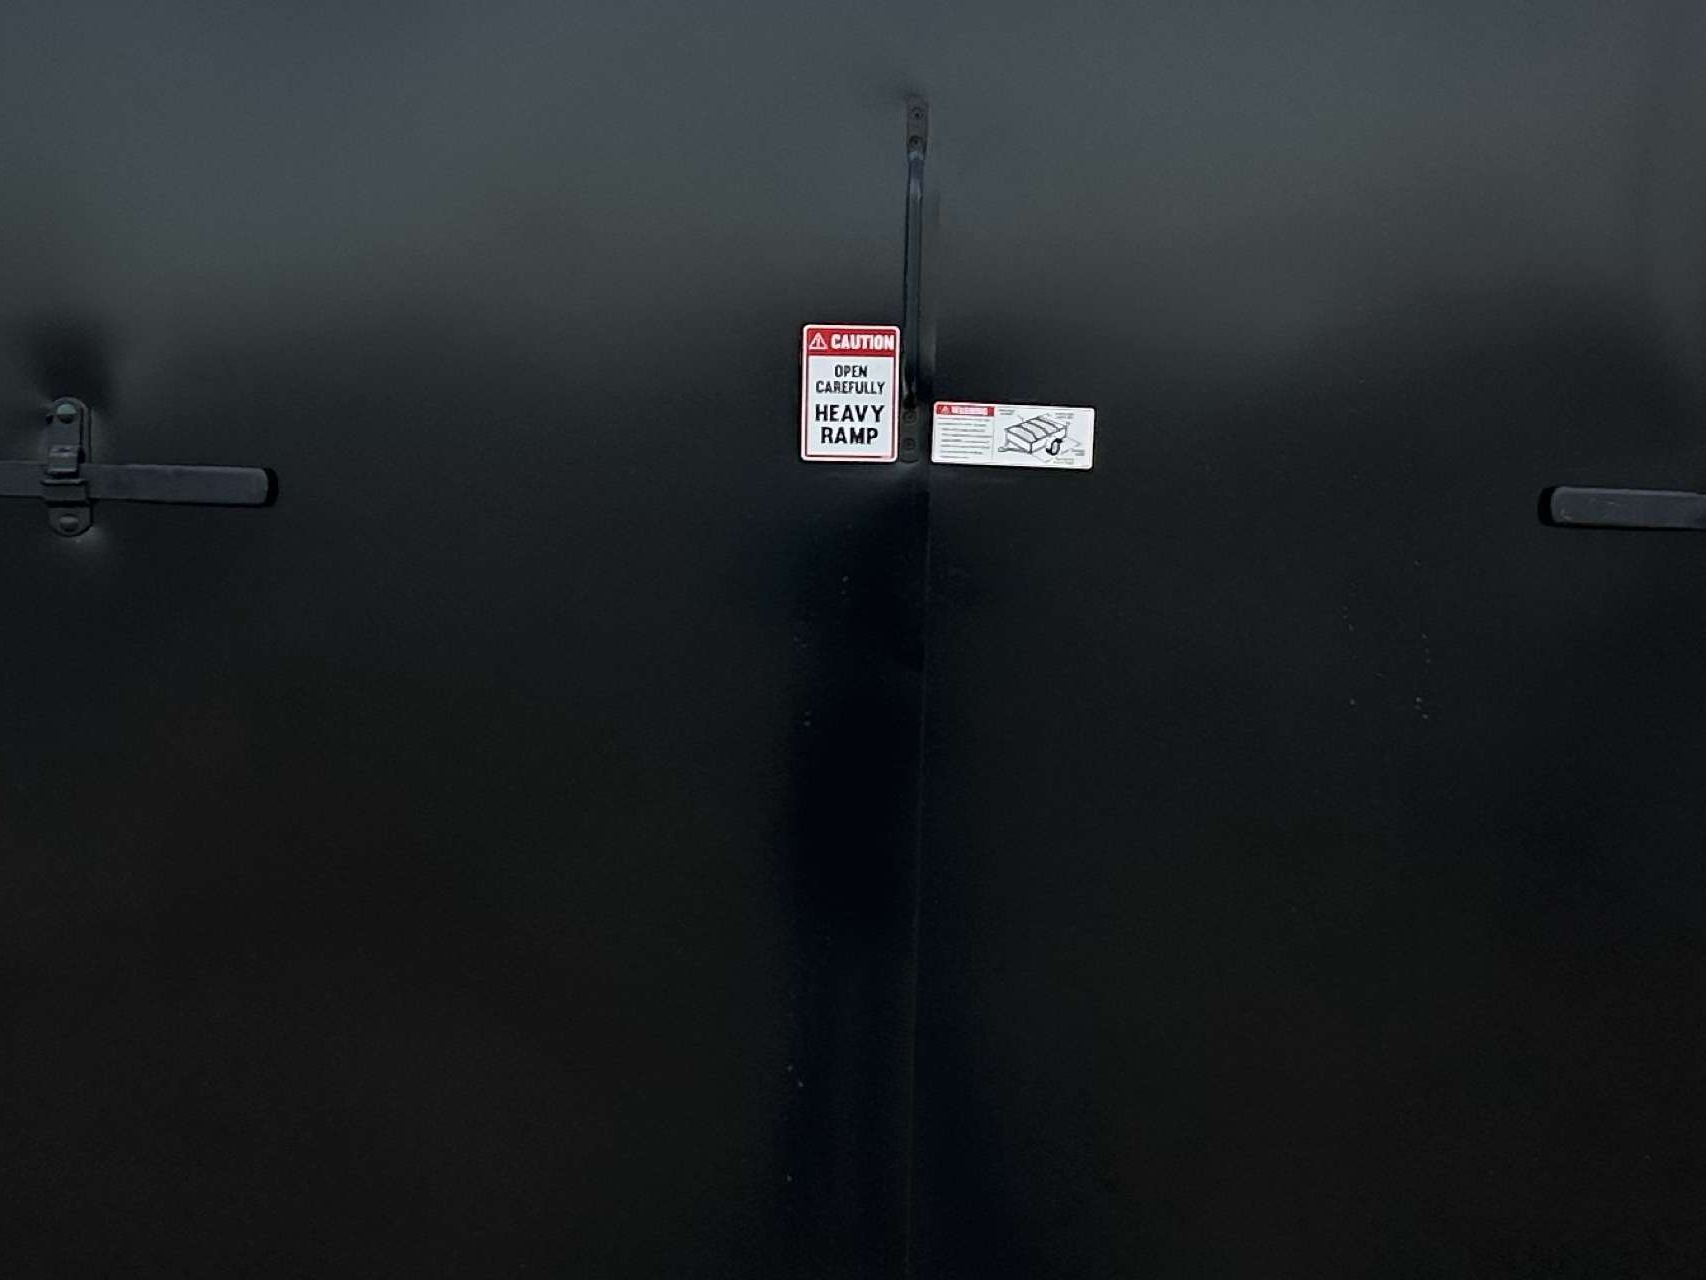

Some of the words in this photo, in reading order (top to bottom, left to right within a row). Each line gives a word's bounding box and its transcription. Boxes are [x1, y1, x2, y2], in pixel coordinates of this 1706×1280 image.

[830, 333, 895, 351] CAUTION
[834, 364, 868, 379] OPEN
[815, 380, 886, 395] CAREFULLY
[815, 403, 886, 423] HEAVY
[820, 426, 879, 445] RAMP
